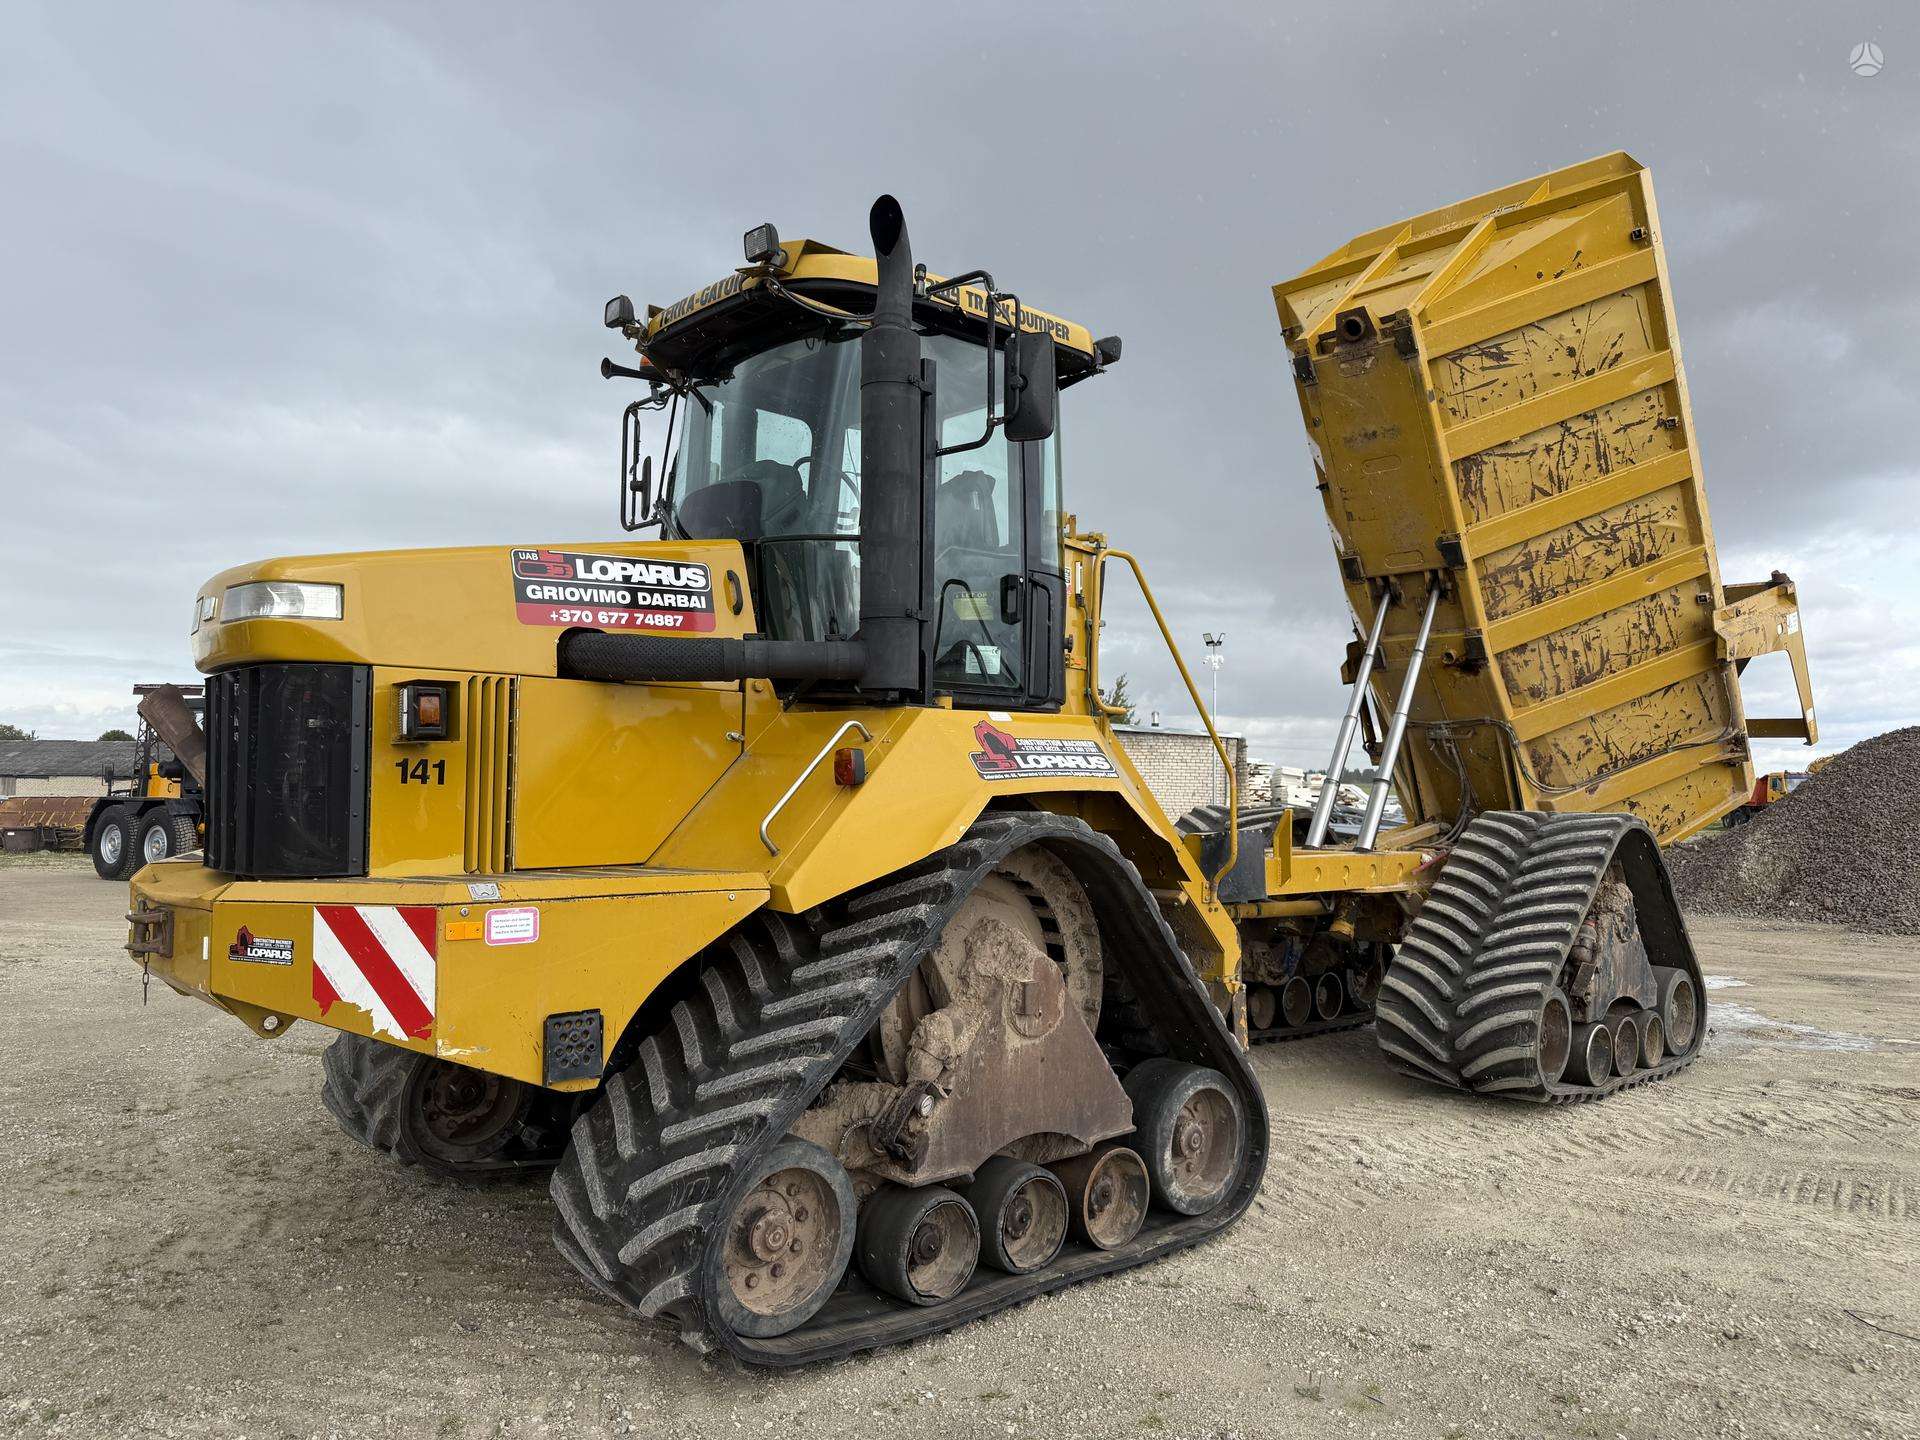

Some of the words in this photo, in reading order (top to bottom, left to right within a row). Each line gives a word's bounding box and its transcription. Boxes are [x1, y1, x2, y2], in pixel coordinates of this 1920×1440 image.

[518, 552, 539, 561] UAB
[575, 558, 706, 588] LOPARUS
[526, 584, 631, 605] GRIOVIMO
[637, 592, 706, 609] DARBAI
[550, 608, 593, 623] +370
[598, 611, 630, 625] 677
[634, 613, 684, 627] 74887
[395, 758, 447, 785] 141
[1014, 754, 1111, 770] LOPARUS
[247, 947, 292, 960] LOPARUS
